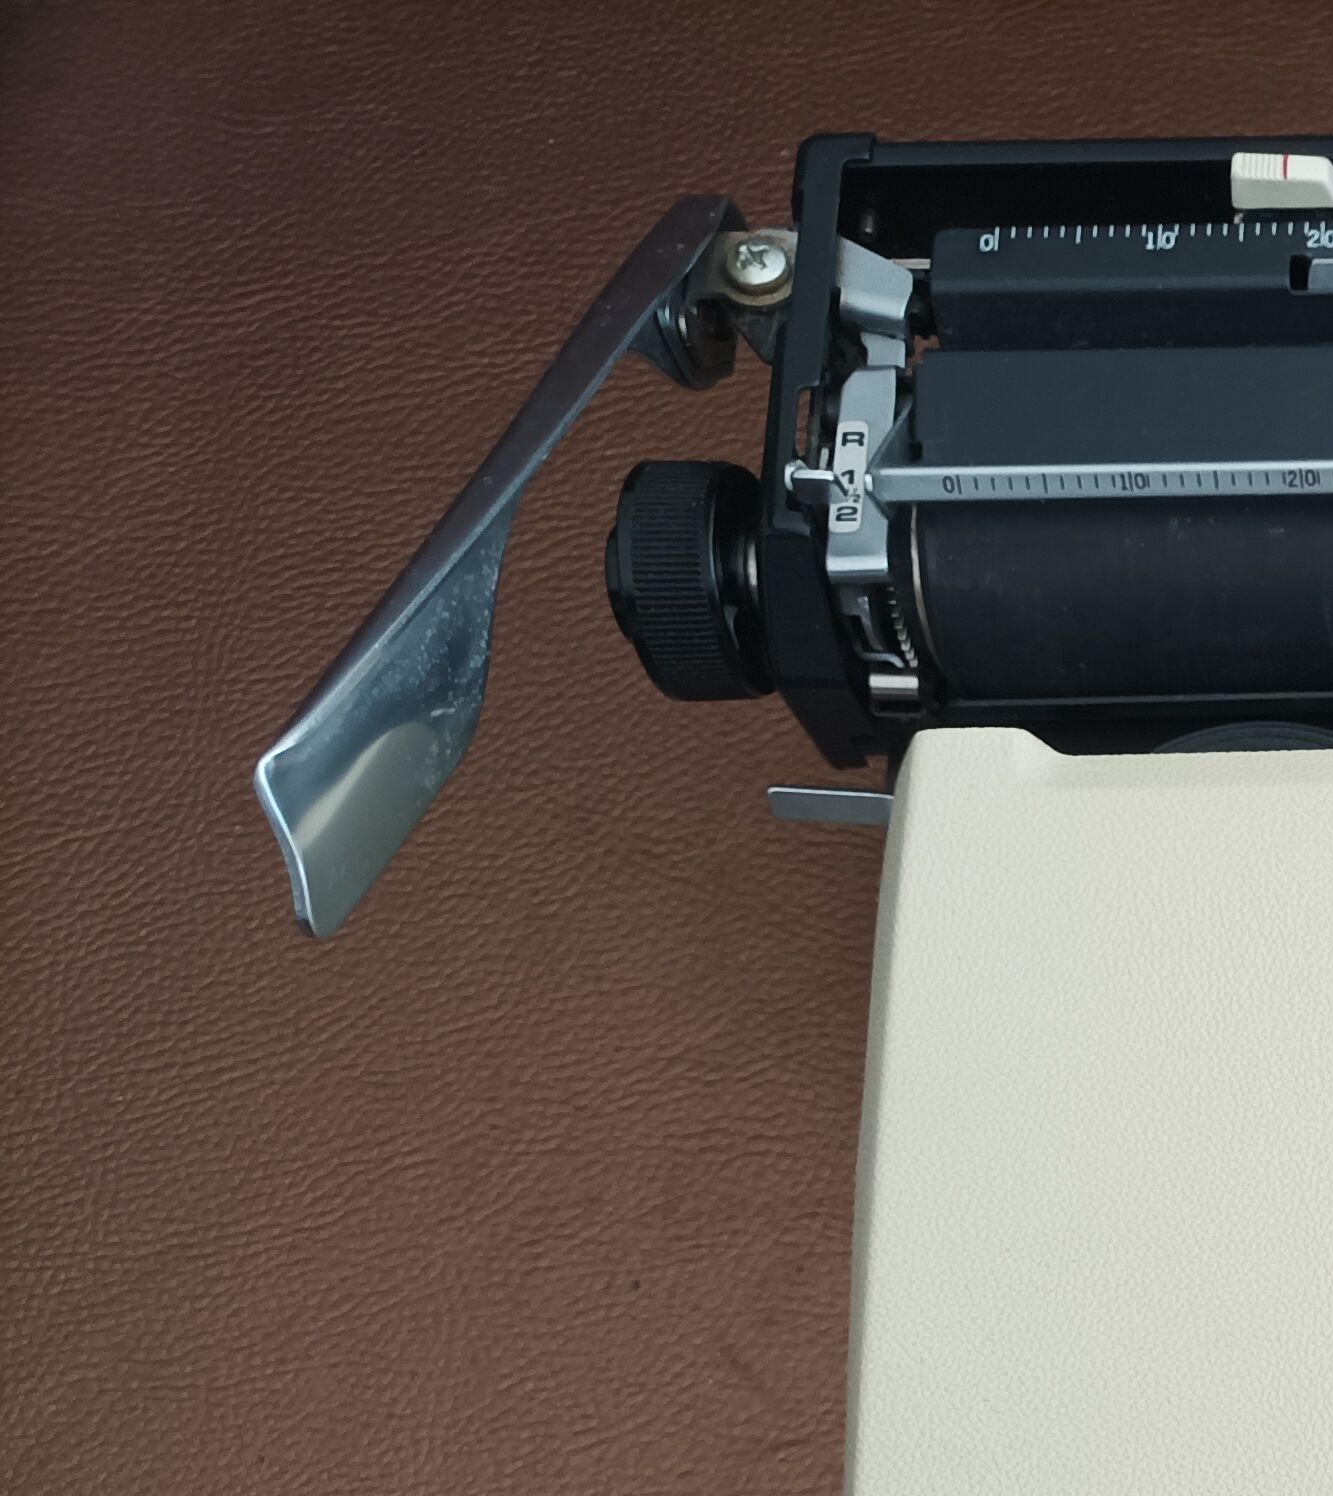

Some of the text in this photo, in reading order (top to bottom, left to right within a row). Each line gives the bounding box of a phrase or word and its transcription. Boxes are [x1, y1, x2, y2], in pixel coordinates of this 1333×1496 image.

[1145, 231, 1177, 250] 10
[842, 431, 865, 447] R
[1119, 470, 1148, 492] 10
[1287, 468, 1316, 489] 20
[835, 505, 858, 522] 2
